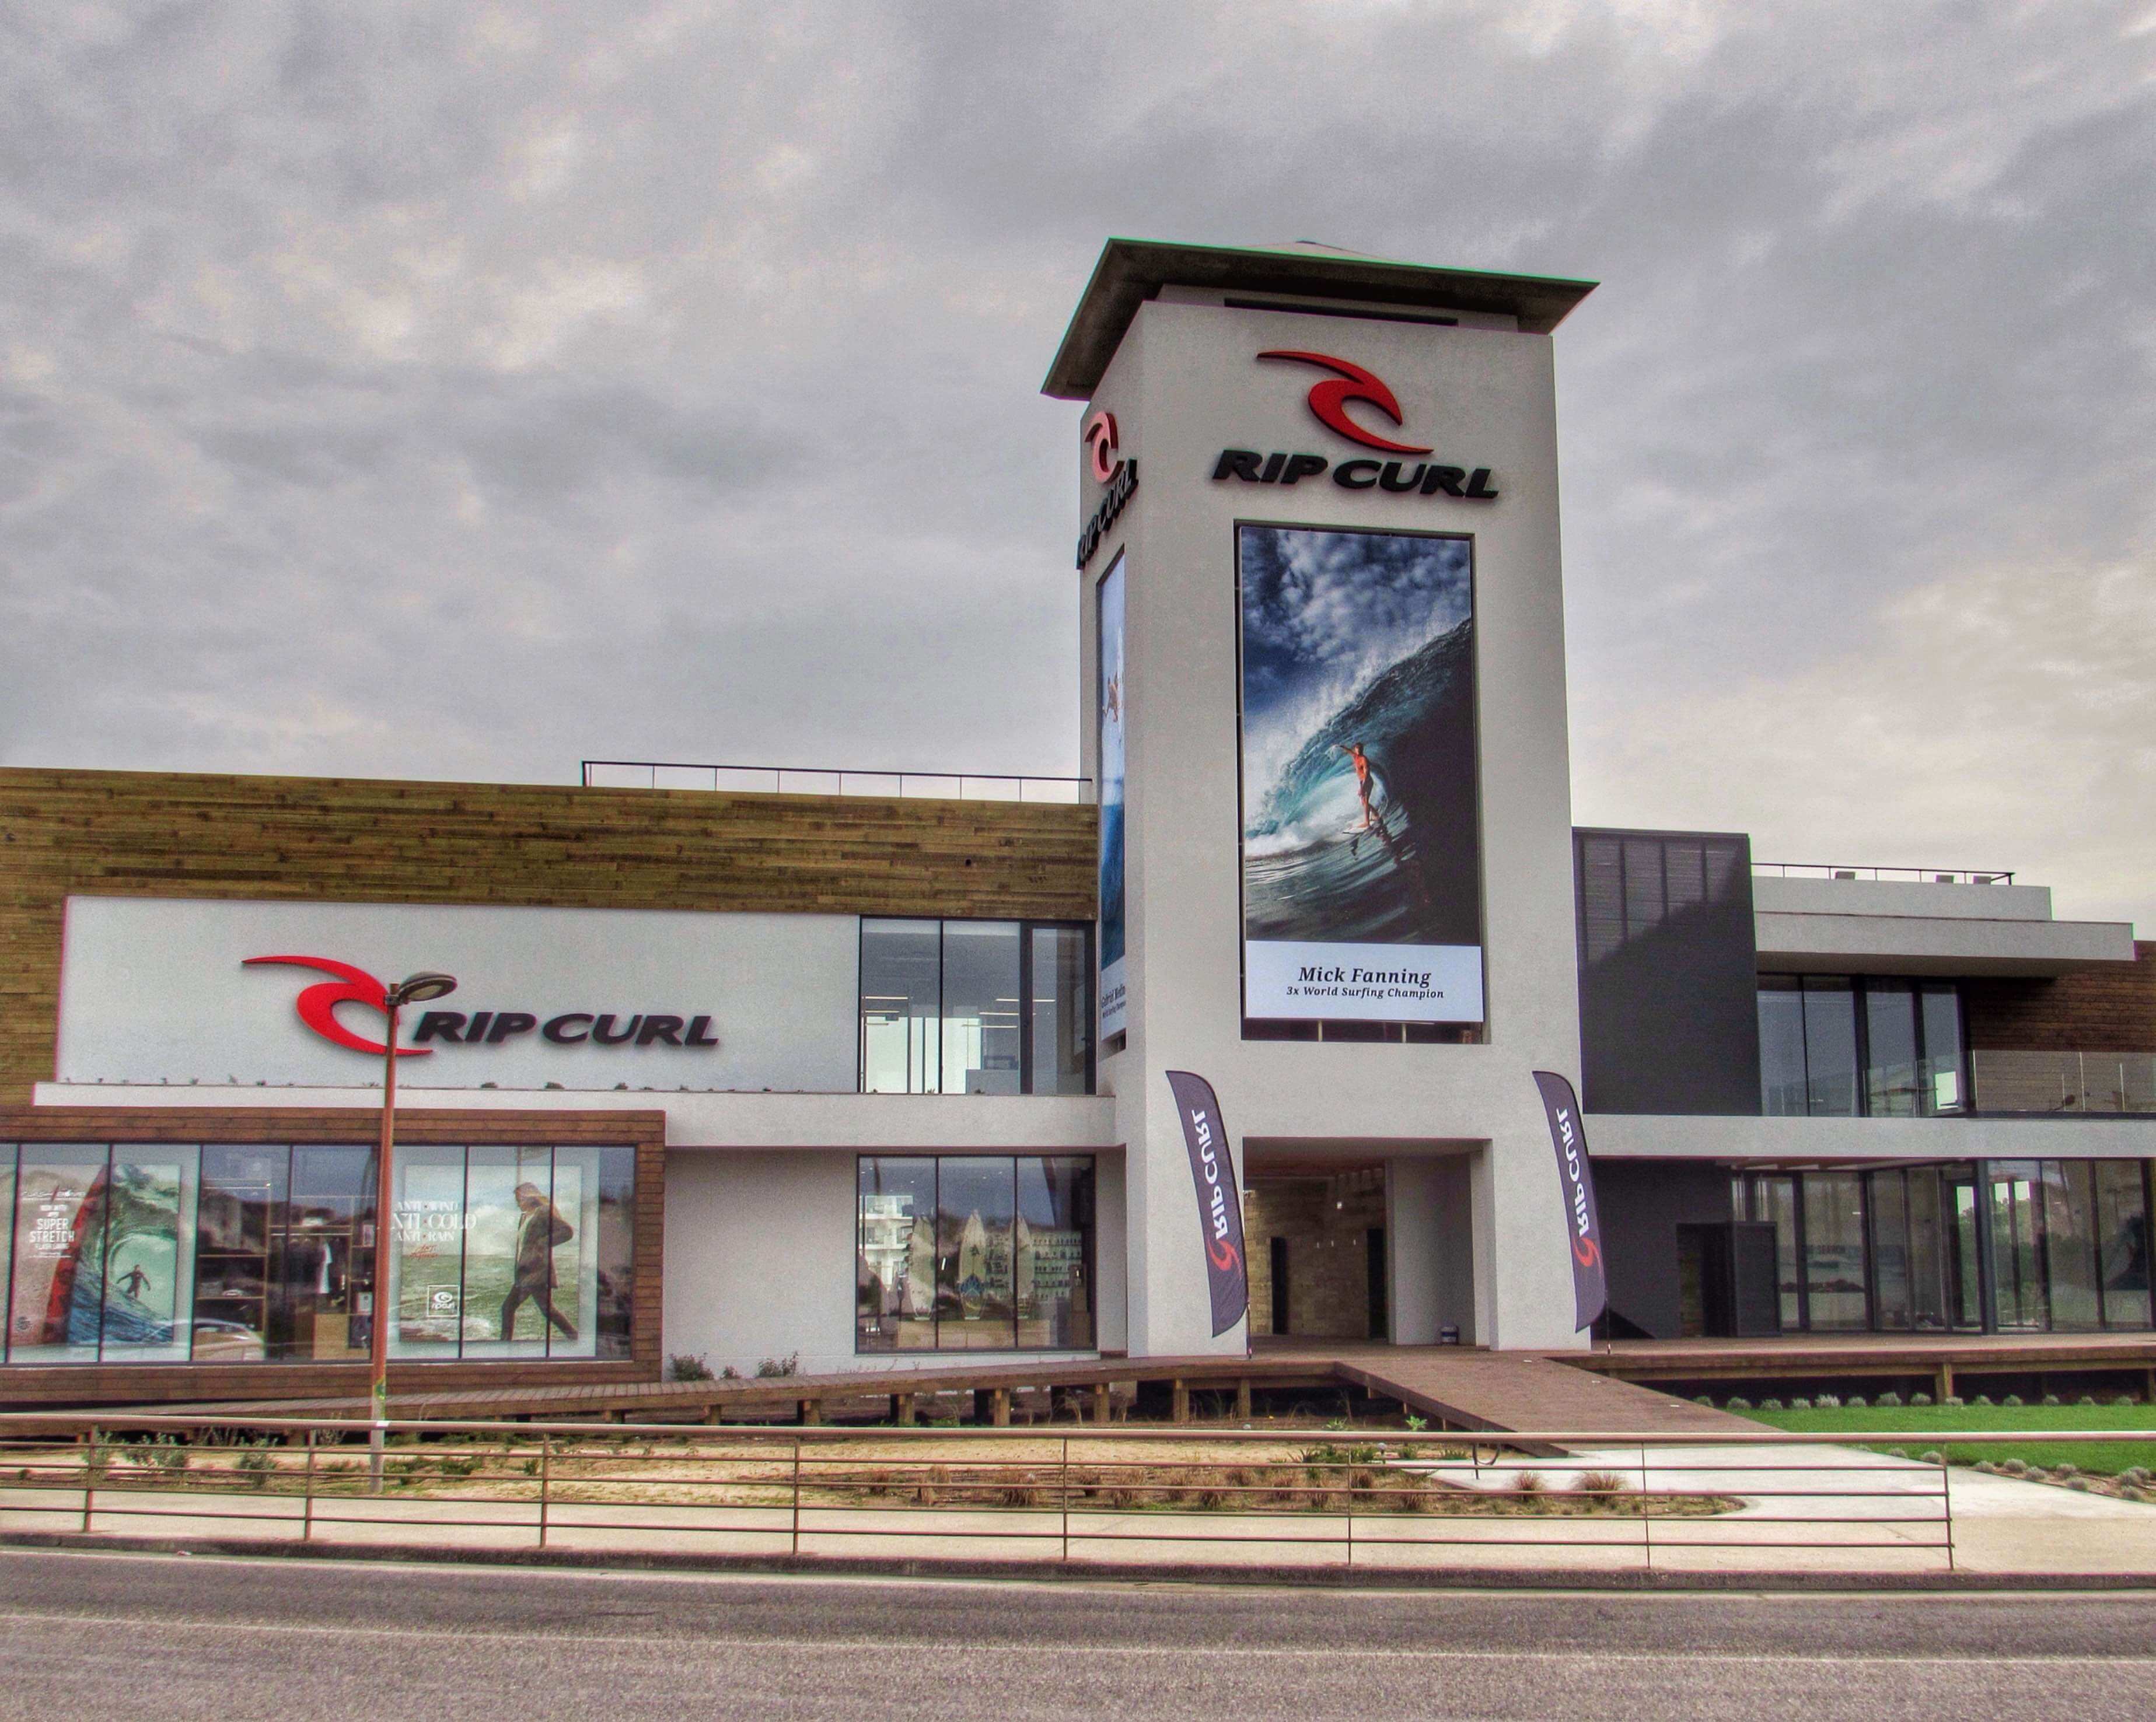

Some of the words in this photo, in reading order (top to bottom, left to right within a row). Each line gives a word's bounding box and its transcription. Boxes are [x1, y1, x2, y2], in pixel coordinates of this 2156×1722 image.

[1212, 450, 1329, 484] RIP
[1333, 459, 1499, 499] CURL
[1298, 967, 1345, 982] Mick
[1351, 968, 1431, 988] Fanning
[1286, 986, 1299, 995] 3x
[1304, 986, 1338, 996] World
[1341, 986, 1383, 999] Surfing
[1387, 988, 1444, 1000] Champion
[413, 1012, 536, 1044] RIP
[542, 1013, 719, 1046] CURL
[37, 1218, 69, 1230] SUPER
[428, 1213, 477, 1230] COLD
[29, 1230, 75, 1243] STRETCH
